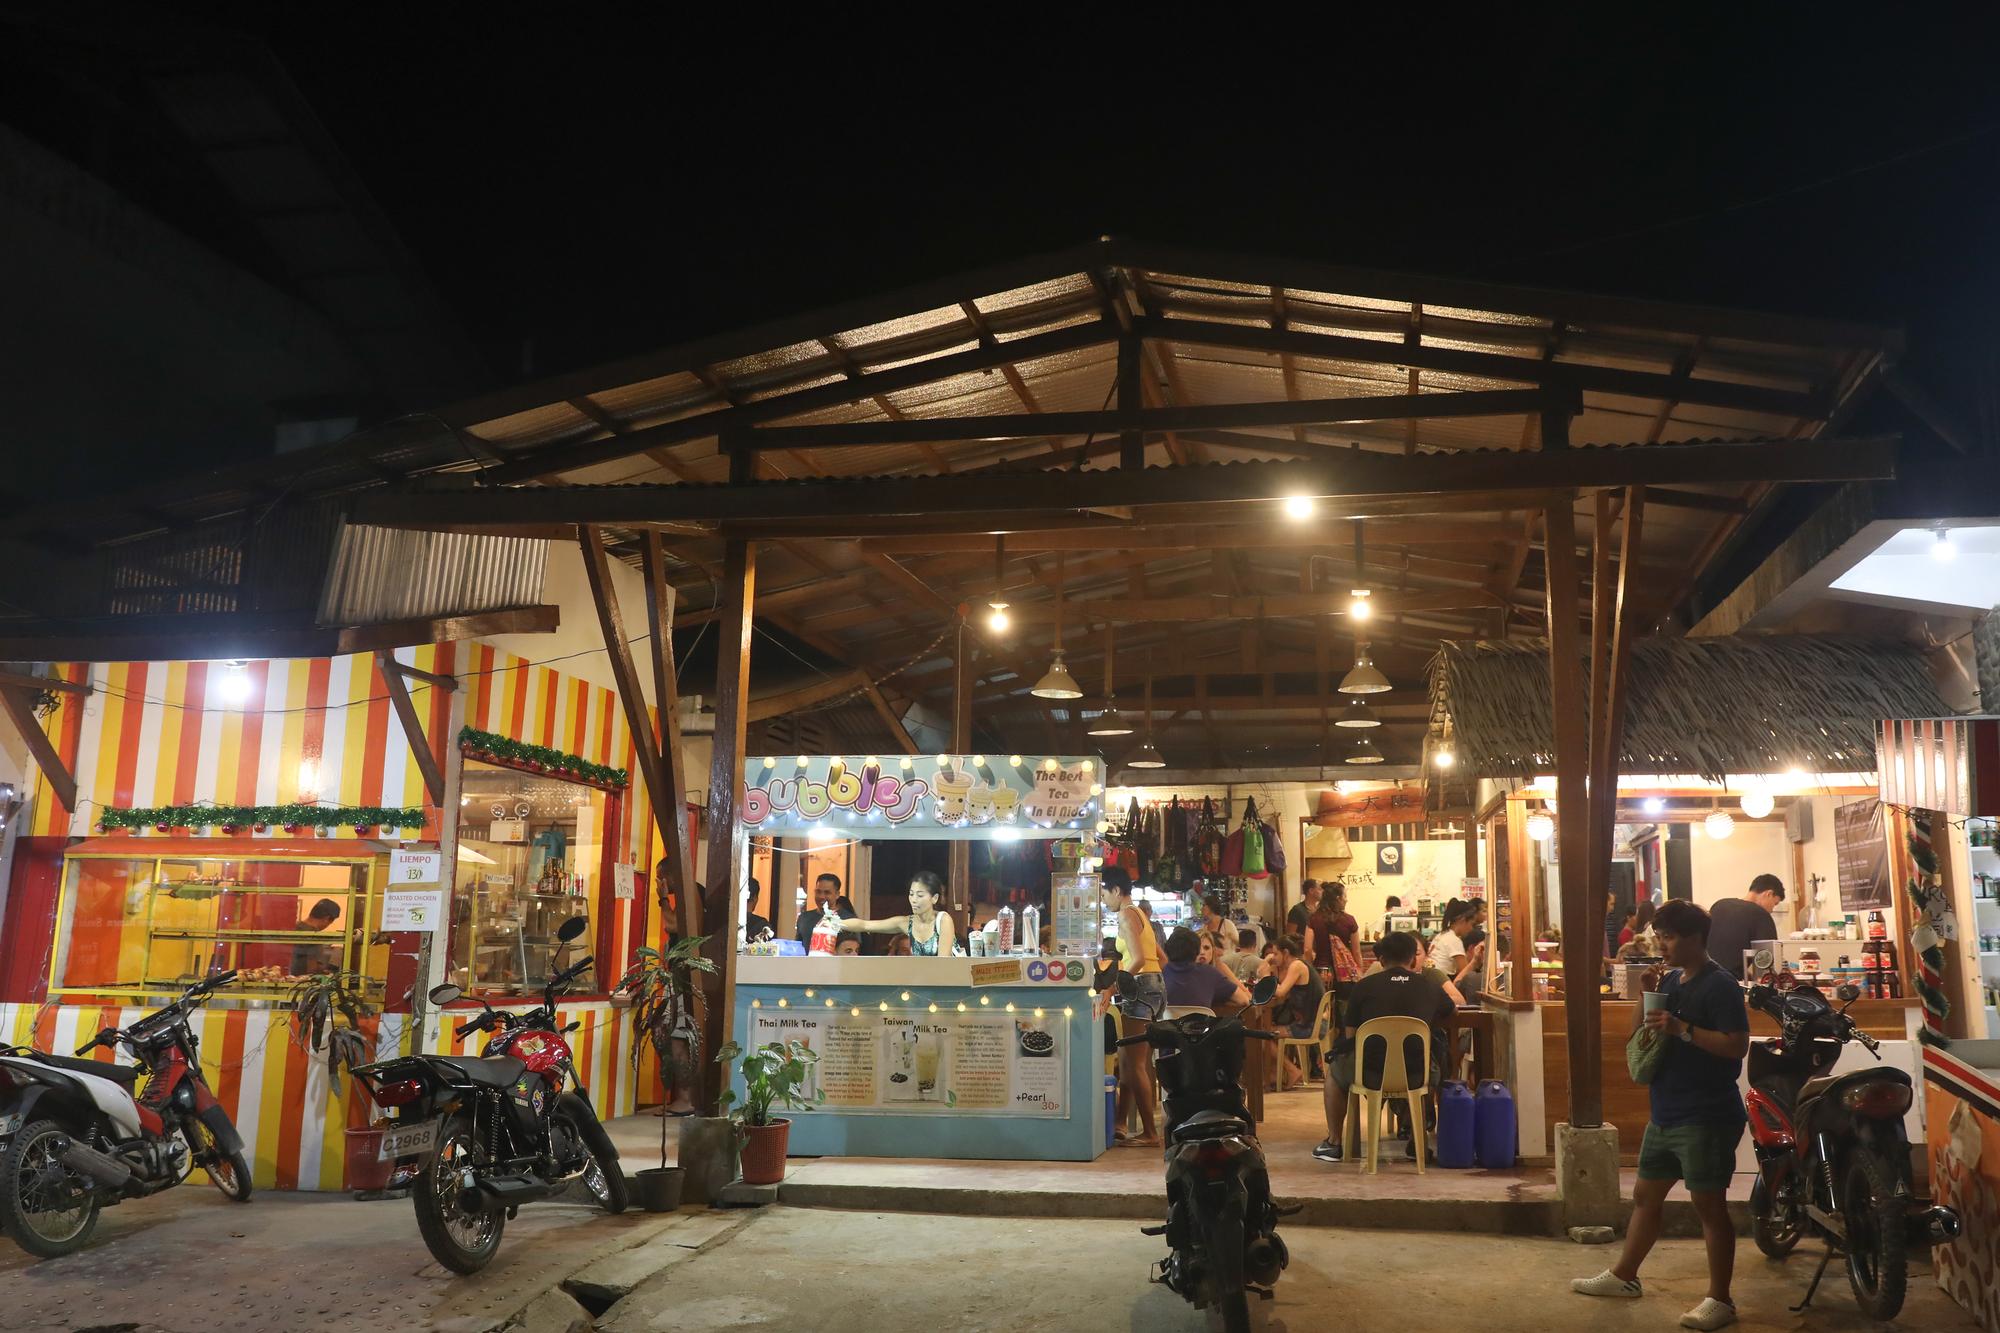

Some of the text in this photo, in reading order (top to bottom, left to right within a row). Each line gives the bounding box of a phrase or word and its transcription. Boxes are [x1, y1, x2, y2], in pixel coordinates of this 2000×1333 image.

[1036, 770, 1083, 781] The Best
[743, 761, 929, 826] bubbles
[1048, 788, 1069, 799] Tea
[1031, 806, 1043, 817] In
[1046, 806, 1057, 817] El
[400, 855, 432, 864] LIEMPO
[758, 1019, 778, 1028] Thai
[780, 1019, 799, 1028] Milk
[801, 1020, 817, 1028] Tea
[883, 1017, 914, 1026] Taiwan
[912, 1025, 931, 1033] Milk
[383, 1130, 430, 1152] C2968
